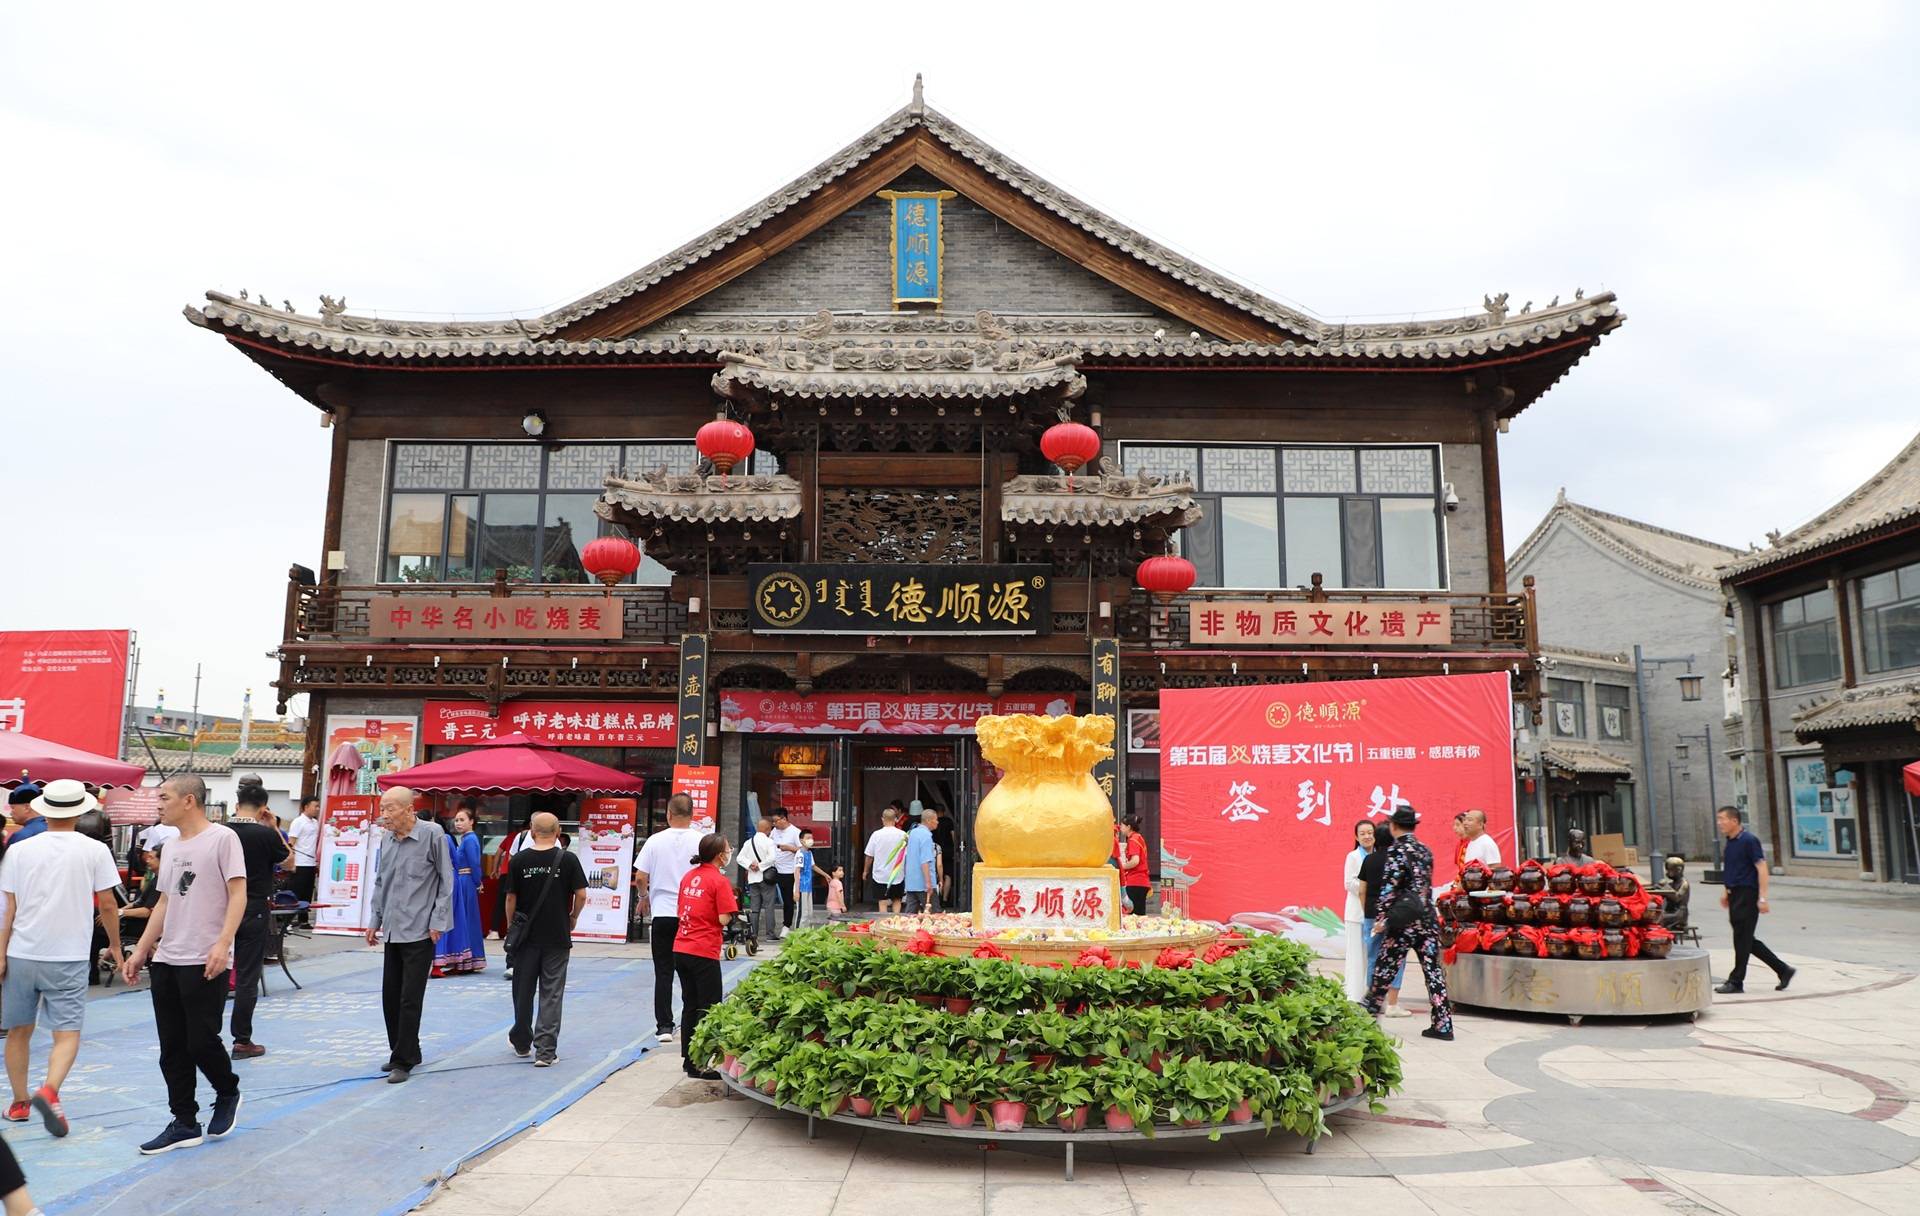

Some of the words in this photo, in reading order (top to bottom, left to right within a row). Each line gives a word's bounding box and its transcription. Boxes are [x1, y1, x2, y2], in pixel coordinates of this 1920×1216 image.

[885, 577, 1032, 625] 德顺源
[390, 606, 602, 631] 中华名小吃烧麦
[1200, 610, 1441, 637] 非物质文化遗产
[512, 711, 675, 732] 呼市老味道糕点品牌
[827, 702, 881, 720] 第五届
[440, 722, 497, 741] 晋三元
[1169, 745, 1228, 766] 第五届
[1251, 742, 1353, 765] 烧麦文化节
[990, 884, 1105, 920] 德顺源
